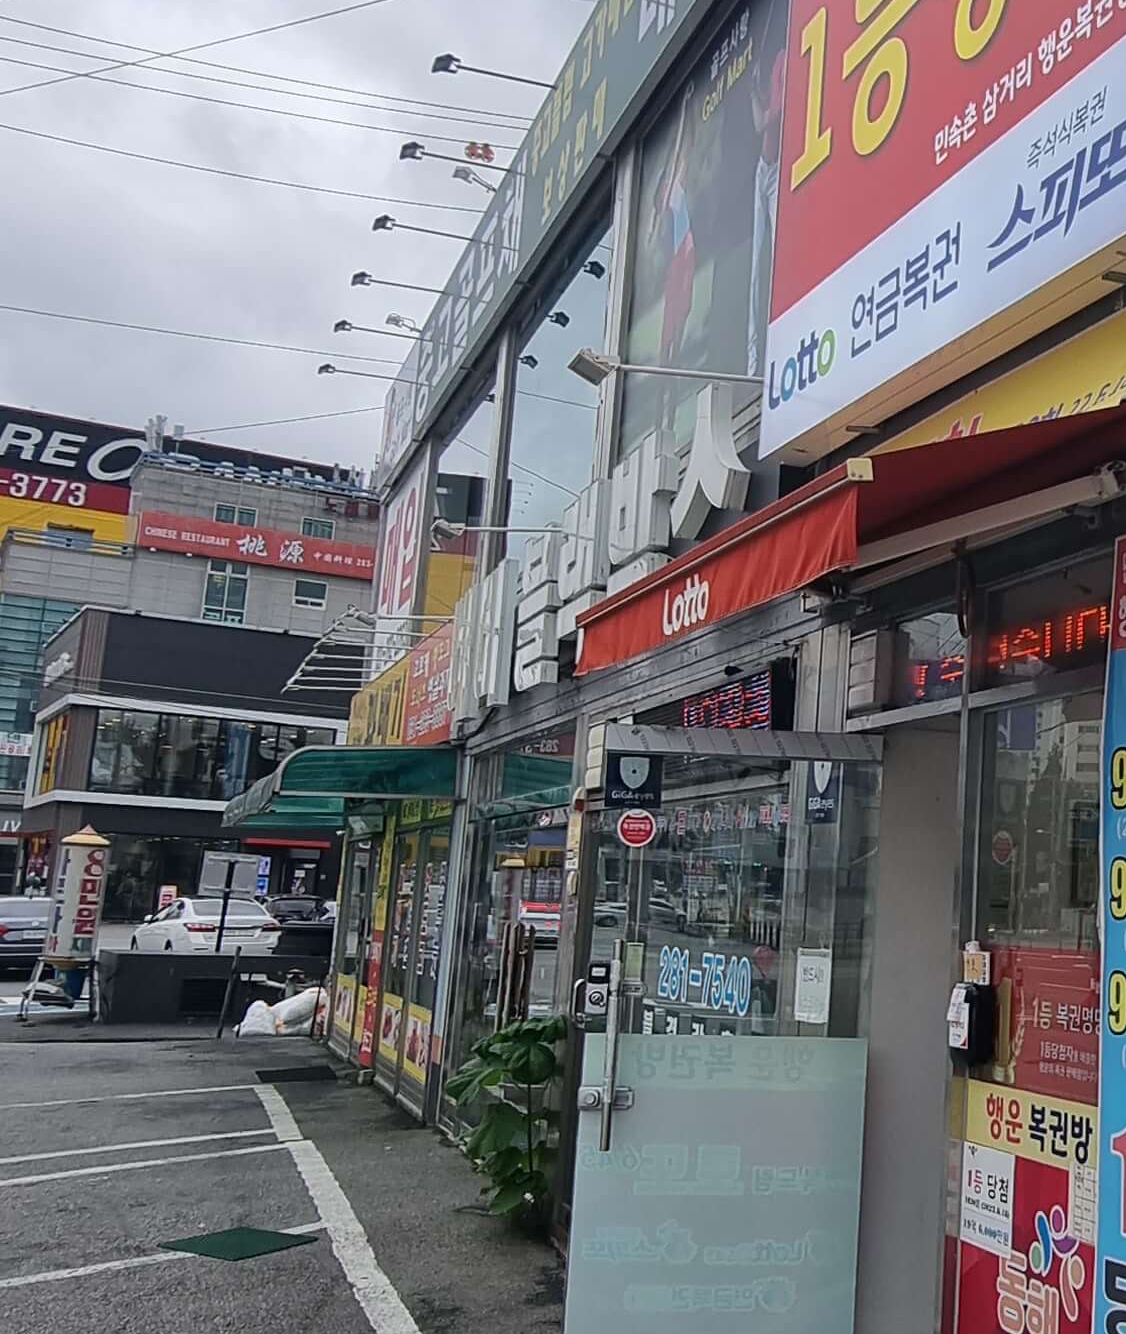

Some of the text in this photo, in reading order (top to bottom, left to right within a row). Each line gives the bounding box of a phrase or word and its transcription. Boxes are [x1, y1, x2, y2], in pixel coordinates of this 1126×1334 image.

[933, 101, 977, 165] 민속촌
[981, 51, 1032, 127] 삼거리
[768, 329, 836, 411] Lotto
[850, 221, 961, 359] 연금복권
[663, 574, 709, 636] Lotto
[657, 944, 752, 1017] 281-7540
[1032, 996, 1052, 1029] 1등
[986, 1092, 1093, 1164] 행운 복권방
[967, 1169, 1009, 1205] 1등 당첨
